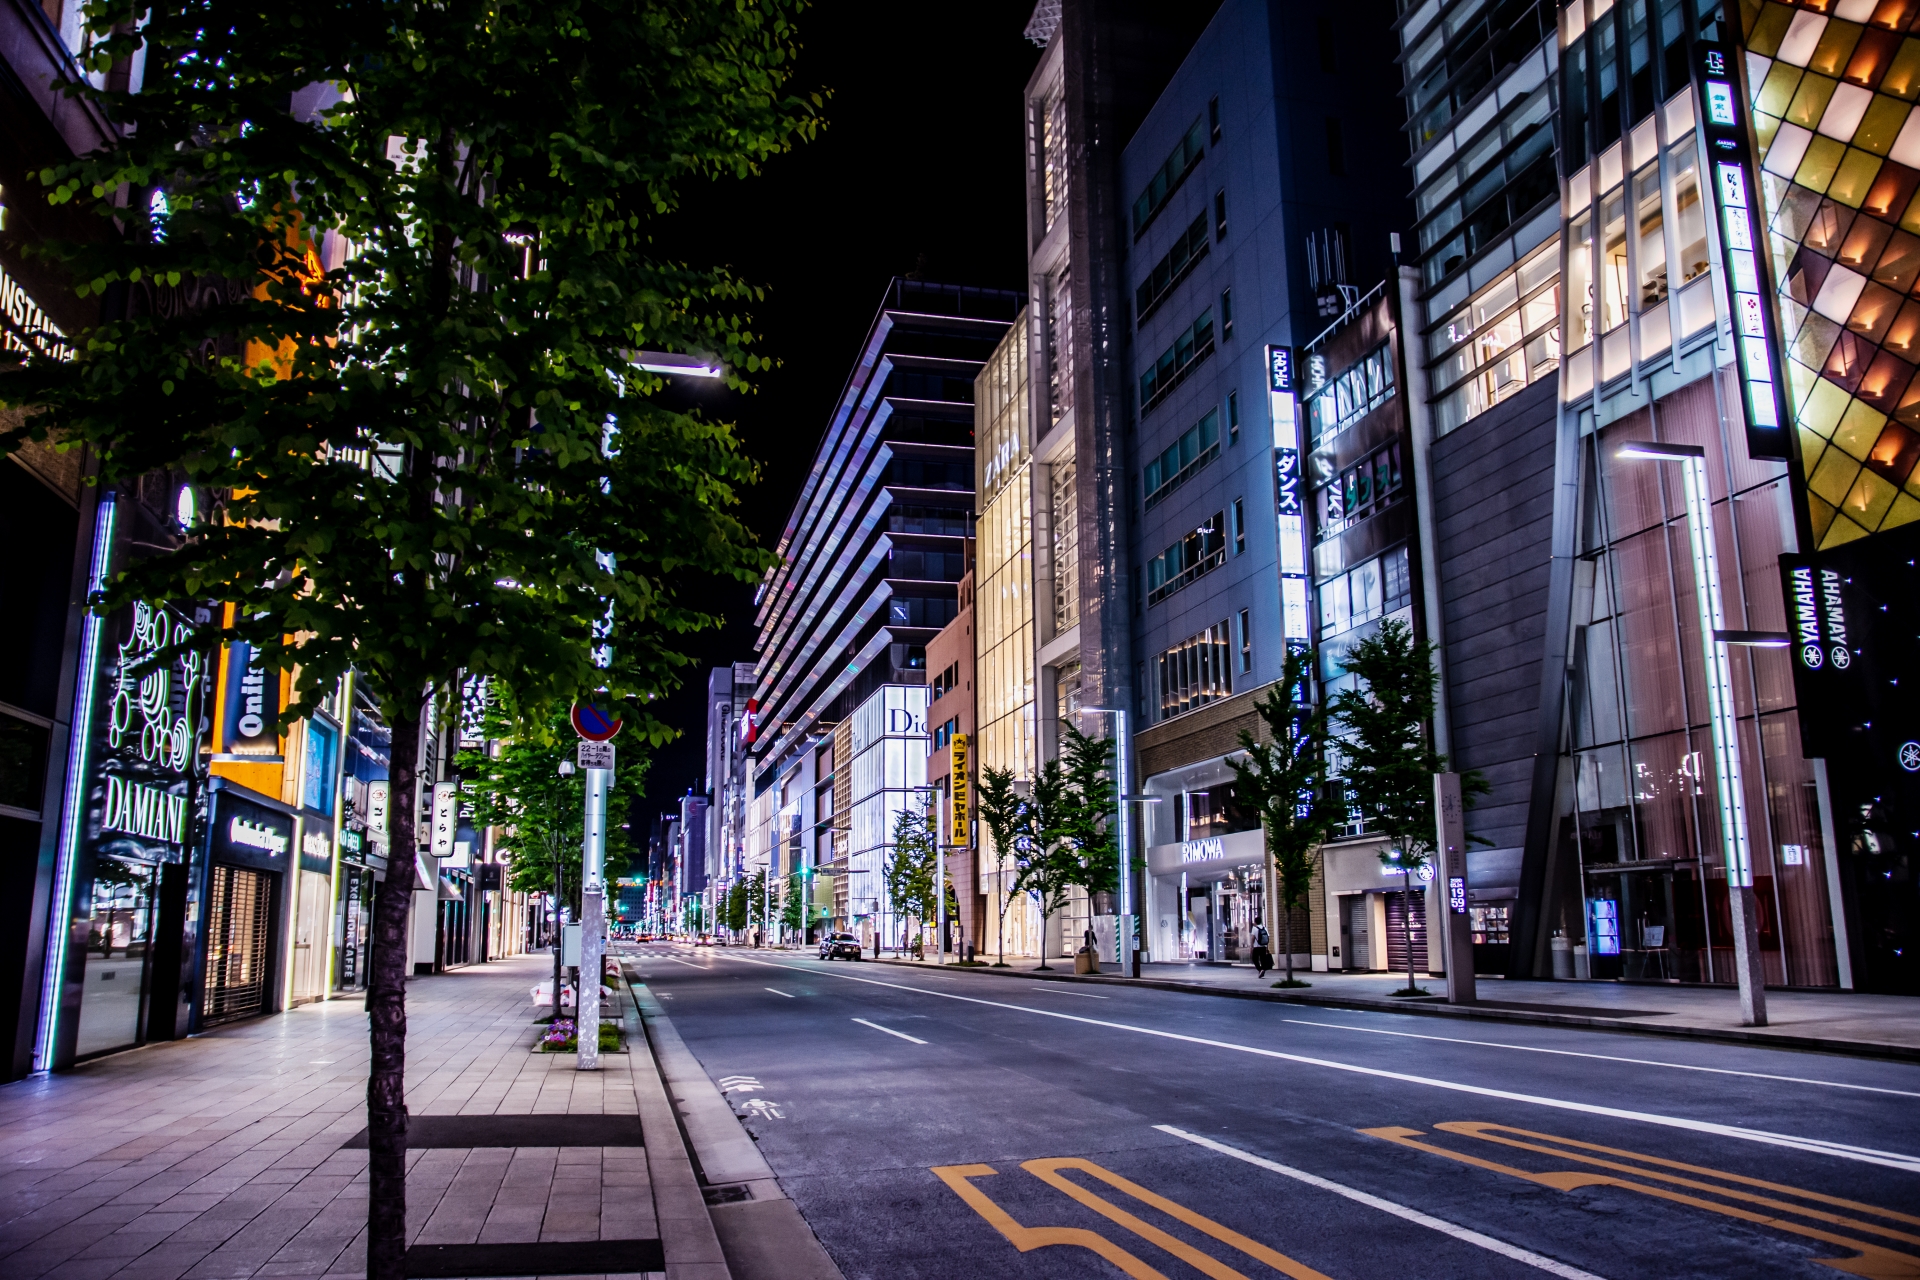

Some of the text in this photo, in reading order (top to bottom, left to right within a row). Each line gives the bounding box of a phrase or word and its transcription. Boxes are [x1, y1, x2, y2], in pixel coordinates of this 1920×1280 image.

[984, 432, 1020, 488] ZARA
[1277, 455, 1299, 510] ダンス
[1791, 568, 1820, 643] YAMAHA
[102, 775, 187, 844] DAMIANI
[953, 751, 966, 838] ライオンビヤホール
[438, 808, 448, 847] とらや
[1182, 838, 1224, 864] RIMOWA
[1451, 888, 1464, 898] 19
[1451, 898, 1465, 908] 59
